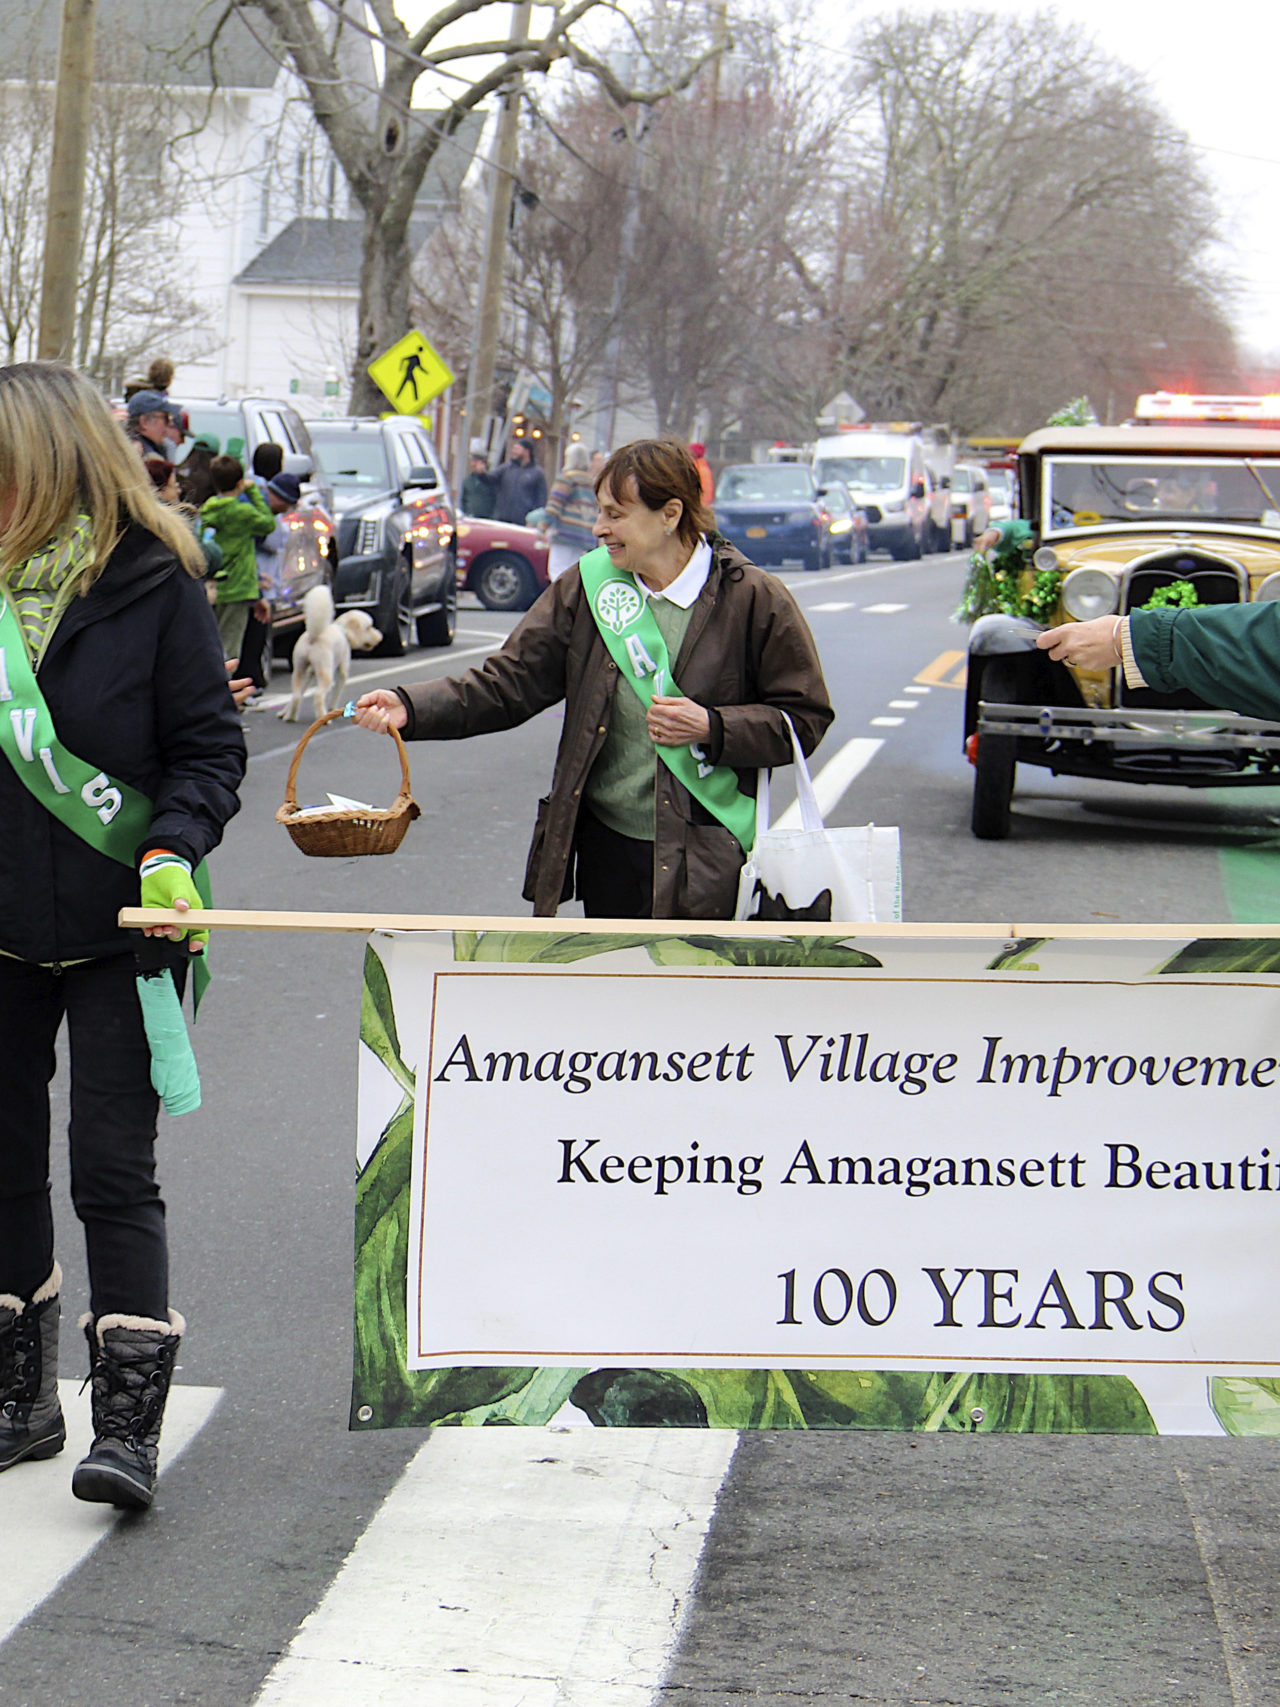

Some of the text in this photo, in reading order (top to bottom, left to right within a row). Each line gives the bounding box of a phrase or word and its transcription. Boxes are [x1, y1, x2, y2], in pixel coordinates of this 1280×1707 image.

[433, 1033, 1280, 1098] Amagansett Village Improveme
[556, 1139, 765, 1196] Keeping
[780, 1139, 1087, 1197] Amagansett
[776, 1267, 1186, 1333] 100 YEARS
